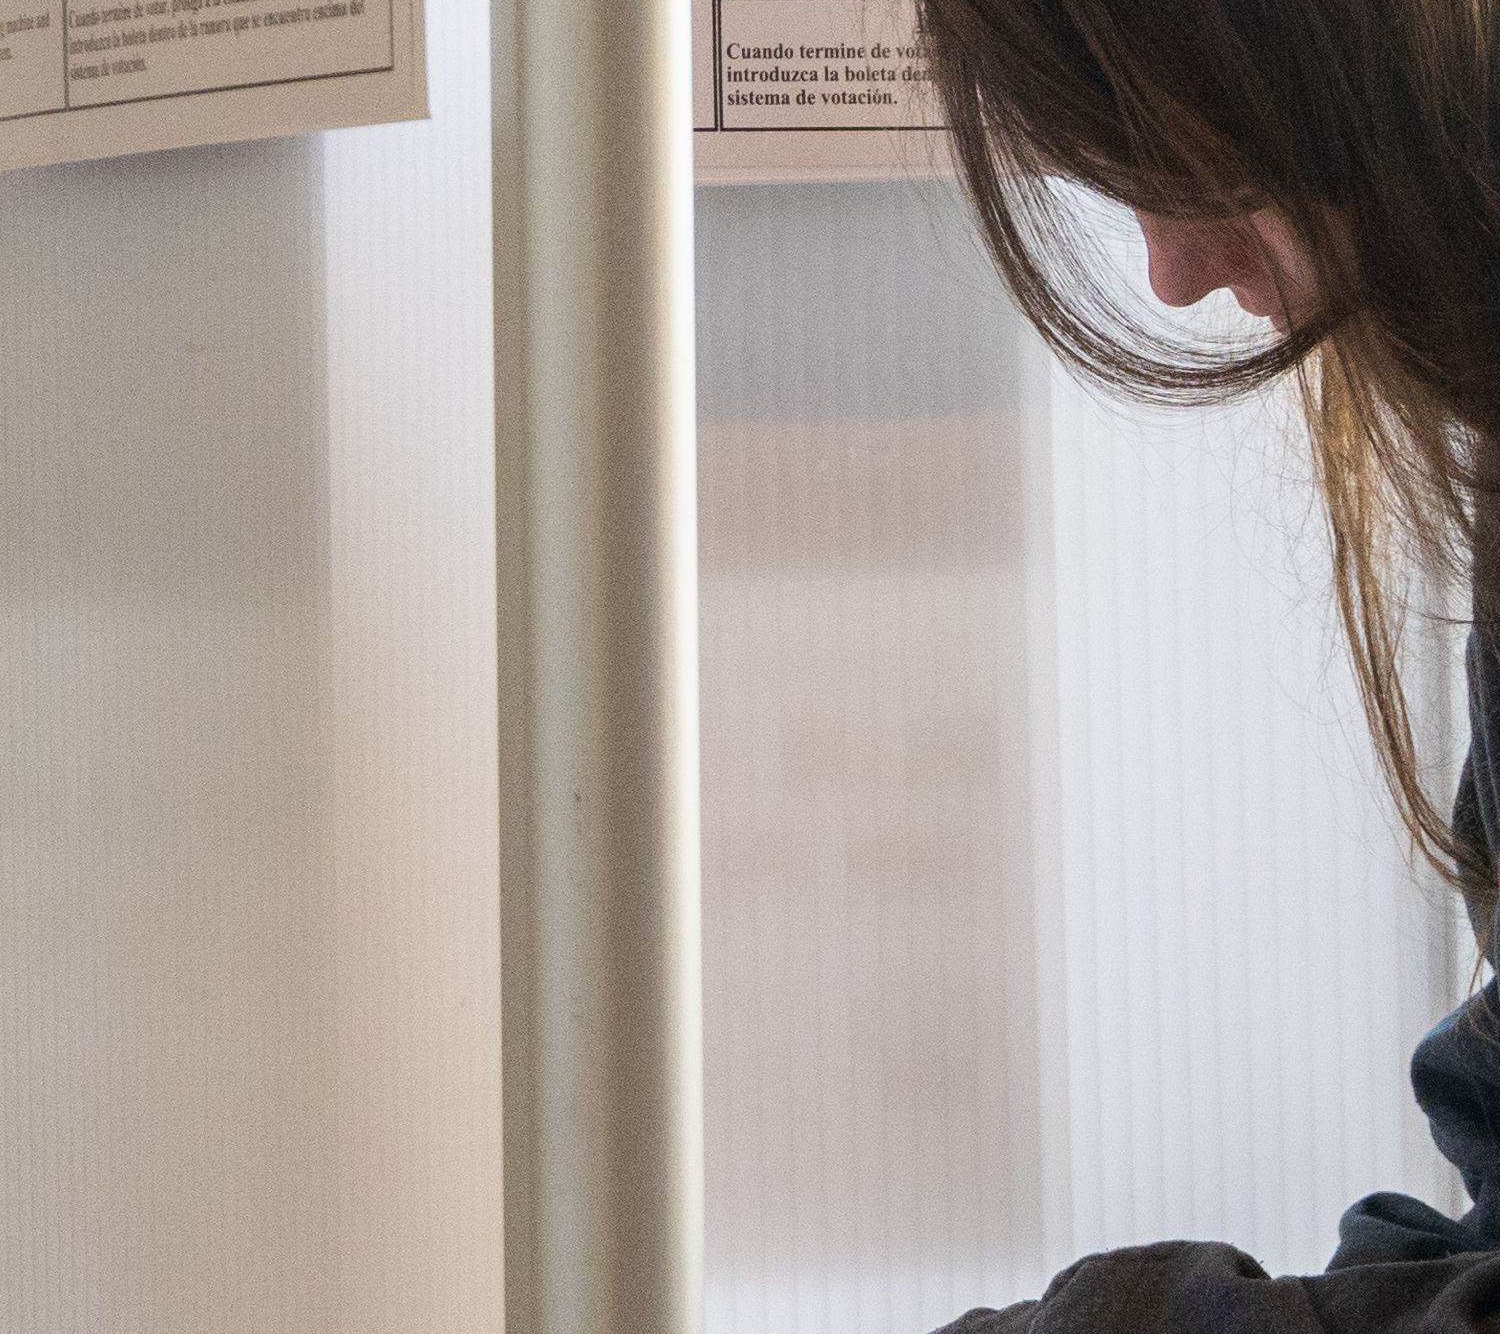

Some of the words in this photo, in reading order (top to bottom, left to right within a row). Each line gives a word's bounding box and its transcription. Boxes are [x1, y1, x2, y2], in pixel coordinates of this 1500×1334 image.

[725, 41, 795, 60] Cuando
[798, 41, 867, 59] termine
[869, 41, 892, 59] de
[726, 64, 820, 83] introduzca
[823, 64, 840, 82] la
[844, 64, 897, 83] boleta
[726, 89, 791, 106] sistema
[794, 88, 816, 106] de
[820, 88, 898, 106] votación.
